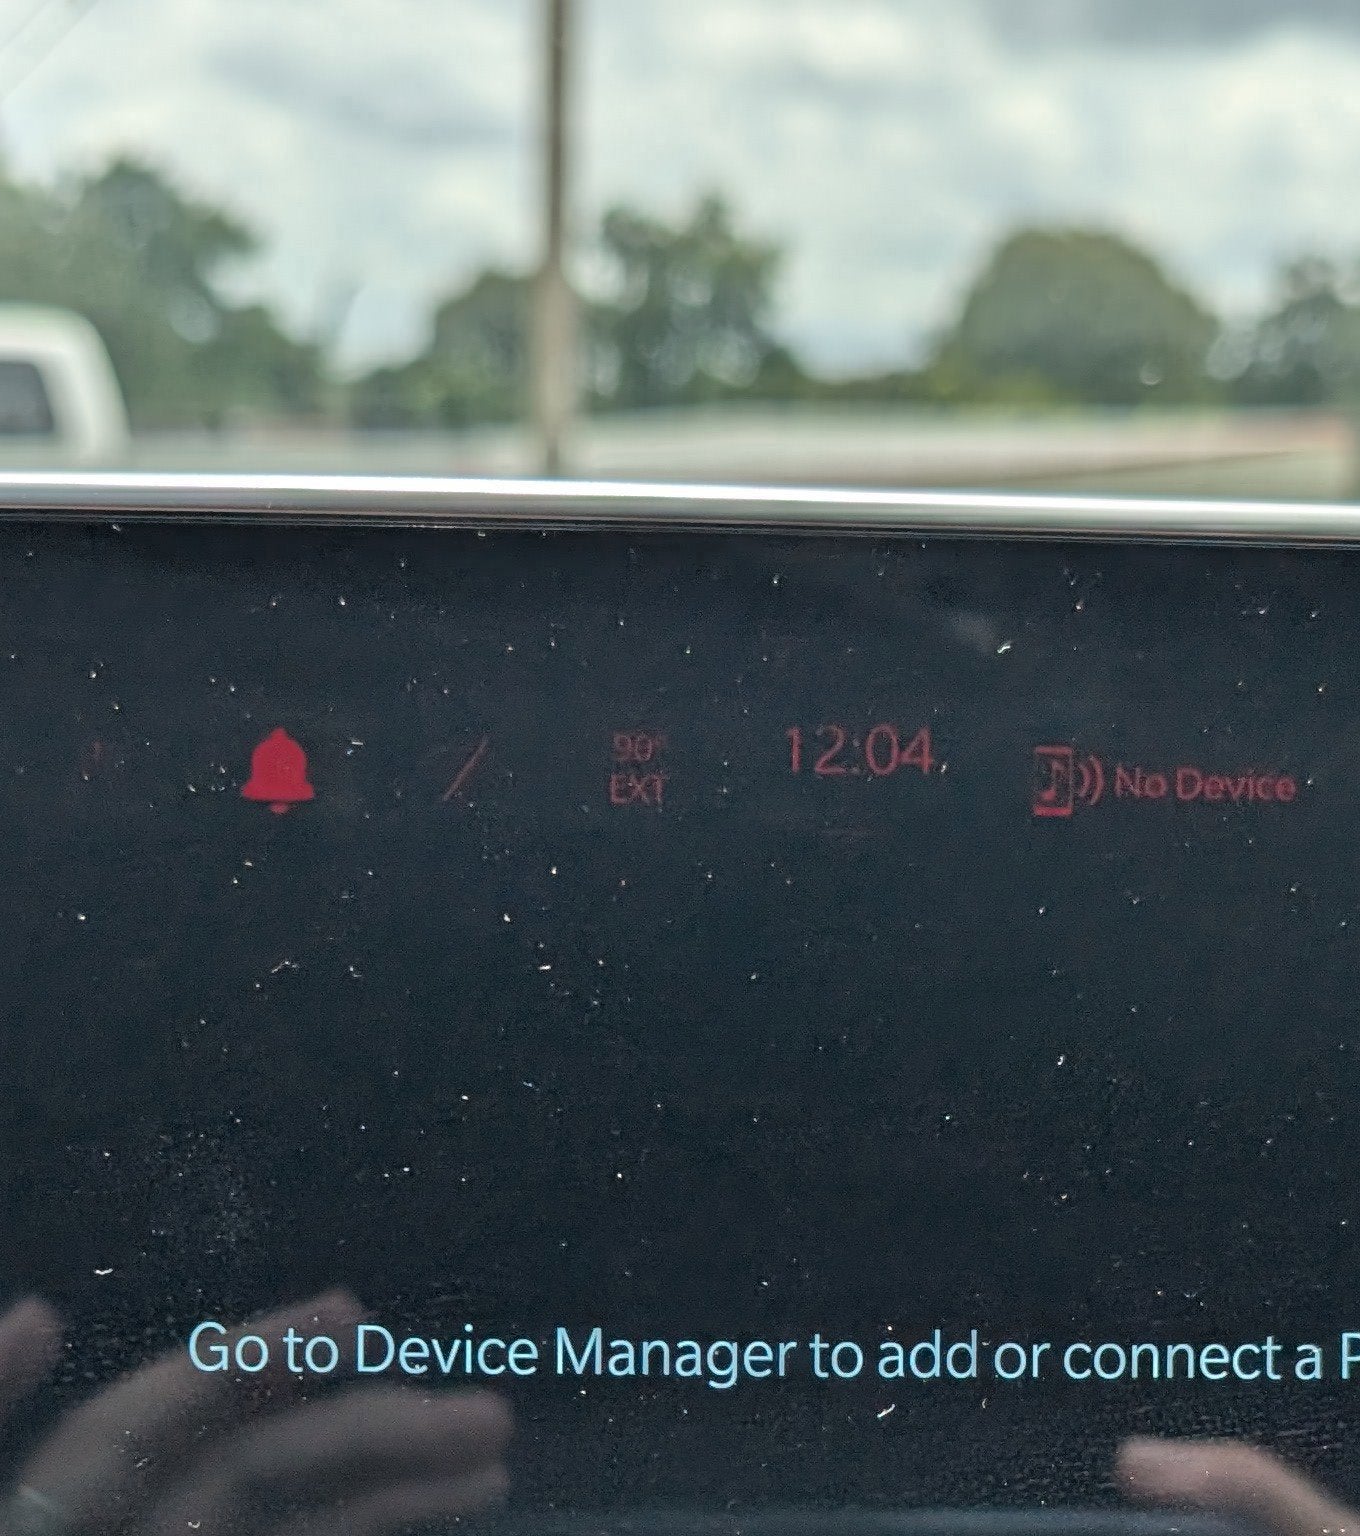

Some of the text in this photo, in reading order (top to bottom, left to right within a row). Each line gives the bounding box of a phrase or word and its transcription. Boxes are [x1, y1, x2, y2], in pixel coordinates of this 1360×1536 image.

[786, 722, 934, 776] 12:04
[1114, 763, 1297, 802] No Device
[187, 1320, 270, 1374] Go
[282, 1329, 340, 1374] to
[355, 1322, 538, 1376] Device
[555, 1325, 796, 1389] Manager
[809, 1332, 864, 1378] to
[877, 1329, 979, 1379] add
[993, 1341, 1050, 1380] or
[1062, 1335, 1282, 1381] connect
[1295, 1342, 1324, 1382] a
